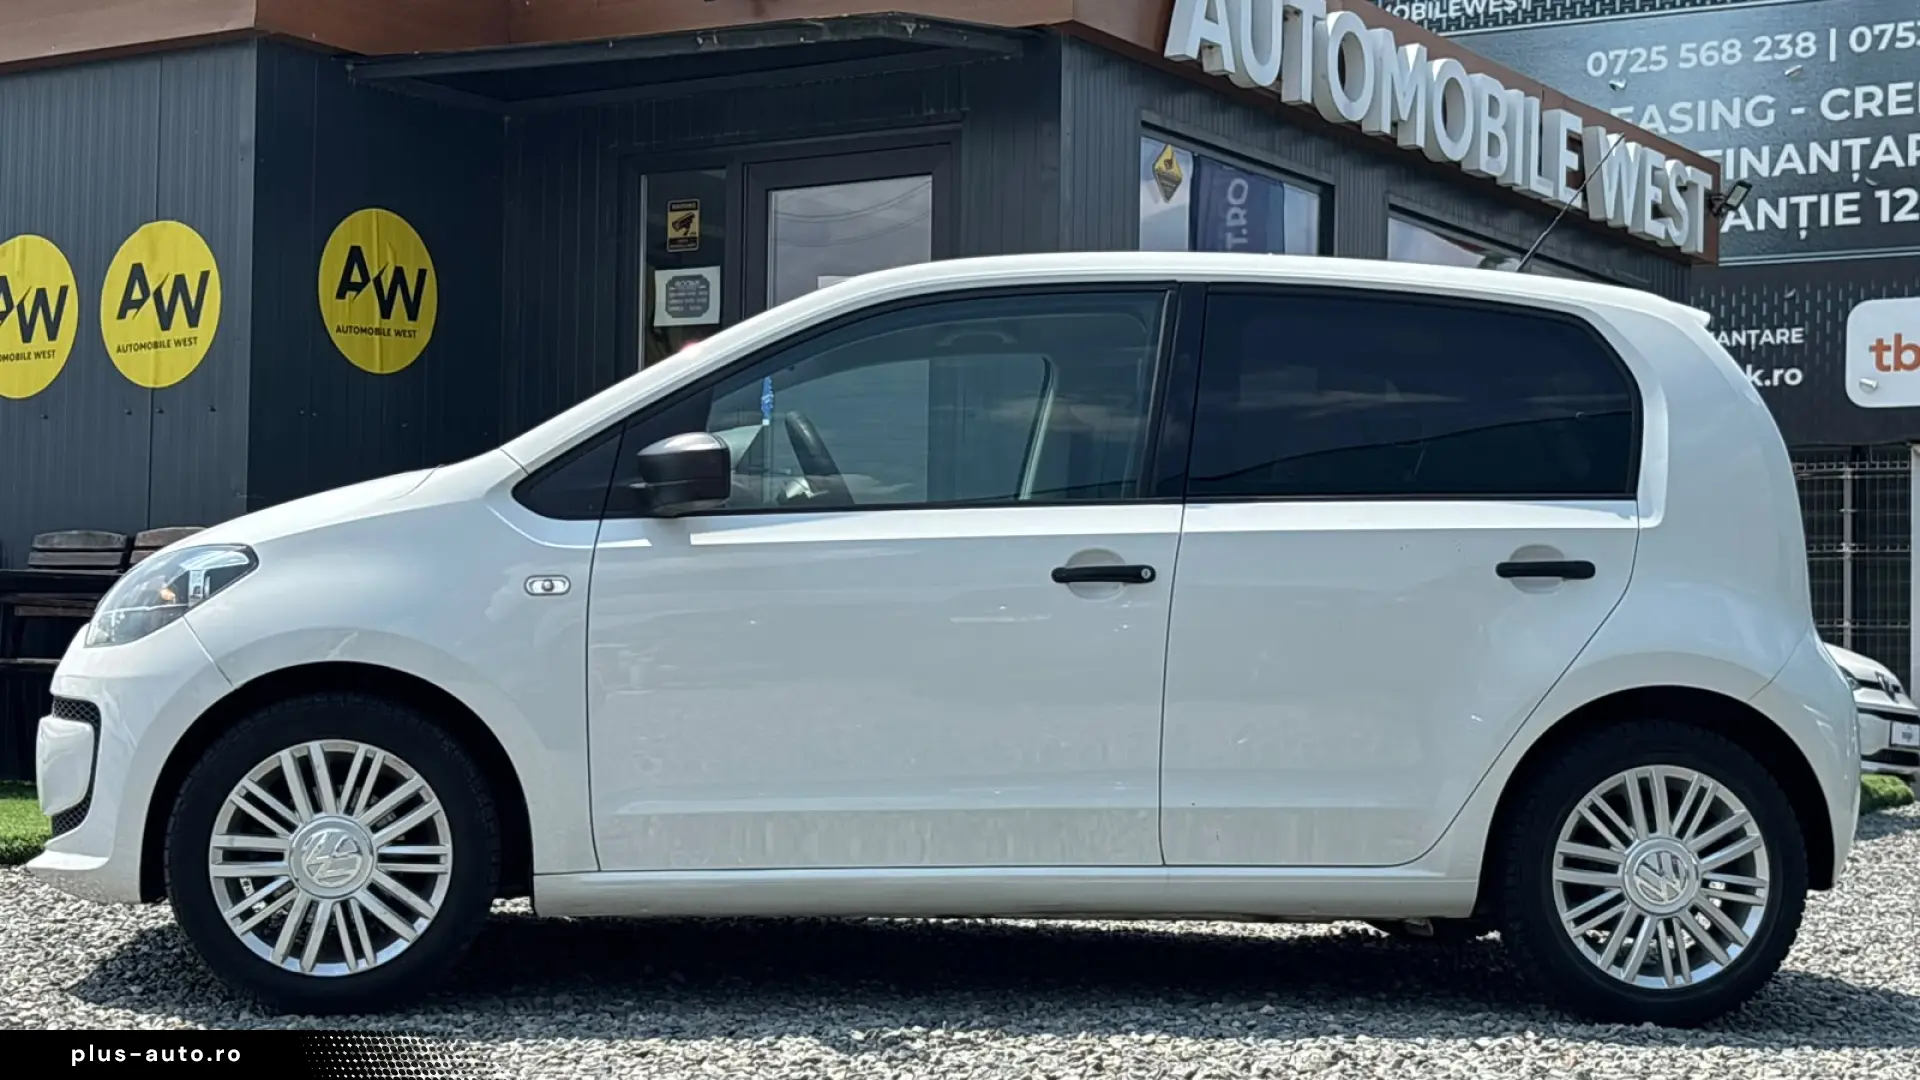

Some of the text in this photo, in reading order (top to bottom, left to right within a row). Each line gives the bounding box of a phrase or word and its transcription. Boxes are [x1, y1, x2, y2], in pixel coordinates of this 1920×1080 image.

[1586, 45, 1668, 78] 0725
[1678, 38, 1742, 69] 568
[1752, 31, 1817, 62] 238
[1849, 20, 1920, 53] 075
[1820, 81, 1920, 122] CRE
[1163, 0, 1713, 254] AUTOMOBILE WEST
[1873, 186, 1920, 223] 12
[116, 336, 199, 354] AUTOMOBILE WEST
[335, 324, 418, 339] AUTOMOBILE WEST
[0, 348, 57, 362] MOBILE WEST
